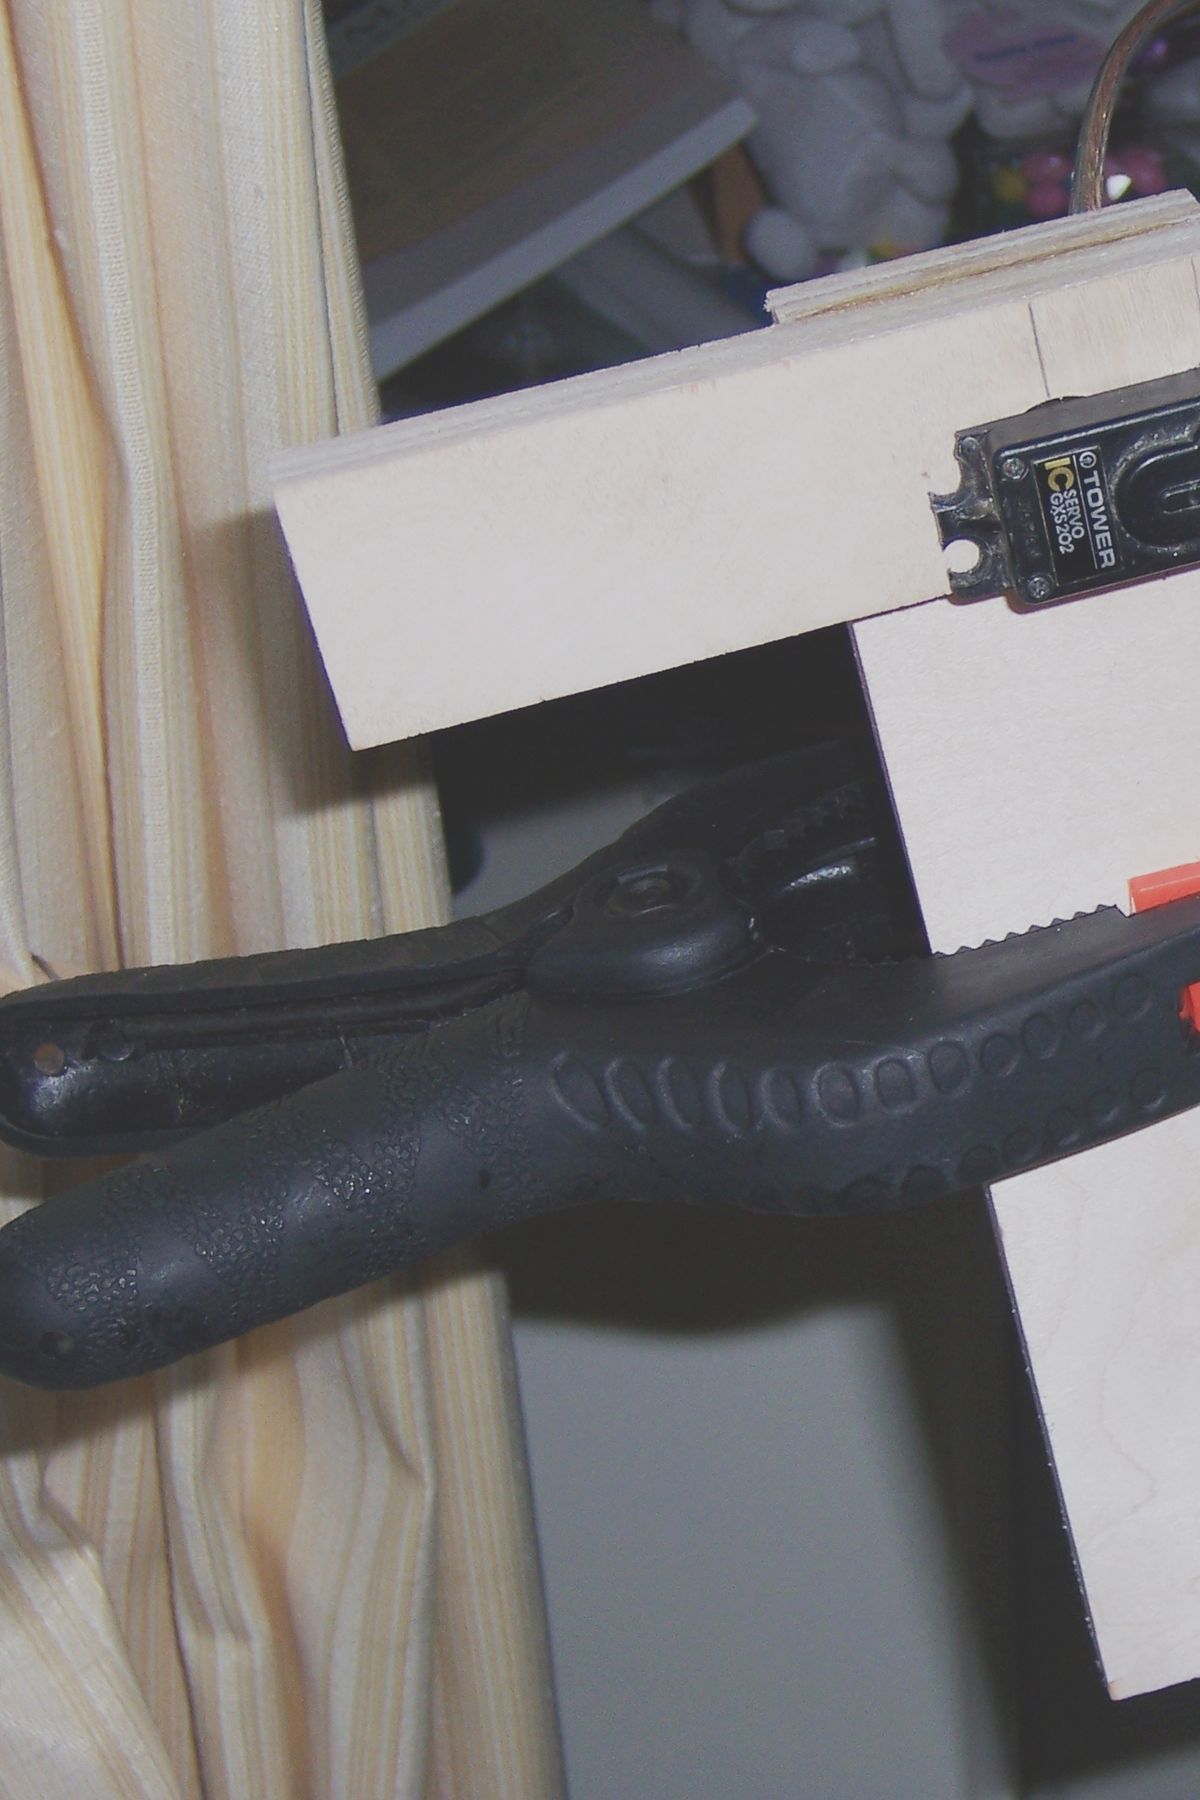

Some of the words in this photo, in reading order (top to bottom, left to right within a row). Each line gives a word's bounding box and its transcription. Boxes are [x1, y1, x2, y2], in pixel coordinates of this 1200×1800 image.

[1044, 457, 1074, 492] IC
[1050, 492, 1075, 555] GXS202
[1063, 488, 1085, 539] SERVO
[1083, 470, 1116, 568] TOWER
